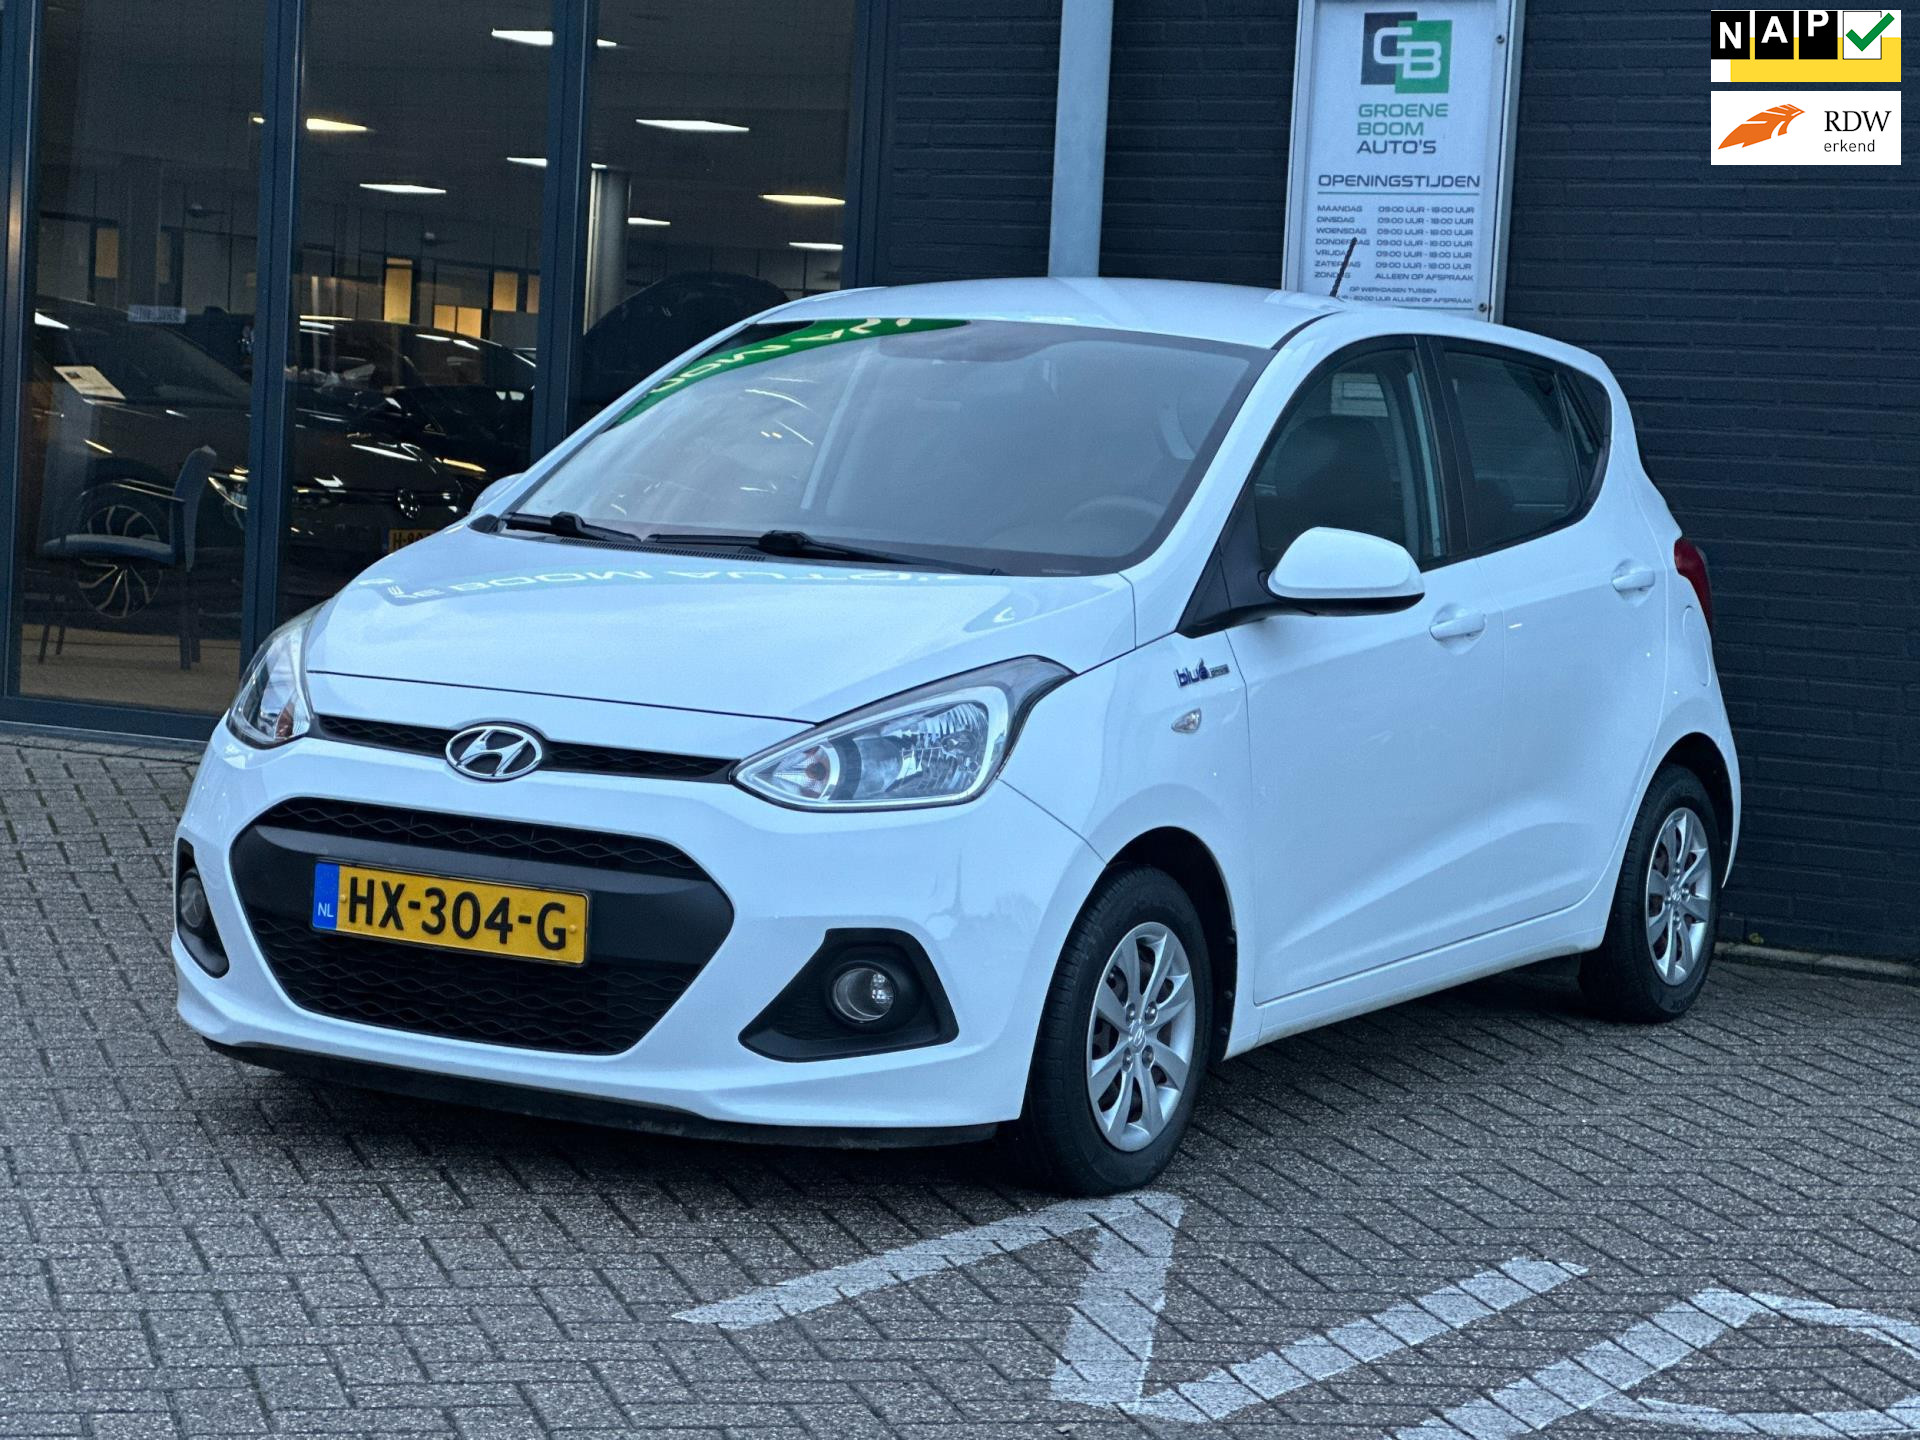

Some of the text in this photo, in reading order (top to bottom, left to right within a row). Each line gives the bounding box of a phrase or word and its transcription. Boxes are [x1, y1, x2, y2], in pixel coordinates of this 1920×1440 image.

[1358, 103, 1448, 118] GROENE
[1357, 122, 1424, 136] BOOM
[1356, 140, 1437, 154] AUTO'S
[1318, 174, 1480, 188] OPENINGSTIJDEN
[1317, 205, 1363, 213] MAANDAG
[1455, 206, 1475, 214] UUR
[1454, 217, 1474, 225] UUR
[1453, 228, 1473, 236] UUR
[1453, 239, 1473, 247] UUR
[1314, 271, 1351, 279] ZONDG
[317, 902, 334, 918] NL
[348, 876, 567, 951] HX-304-G
